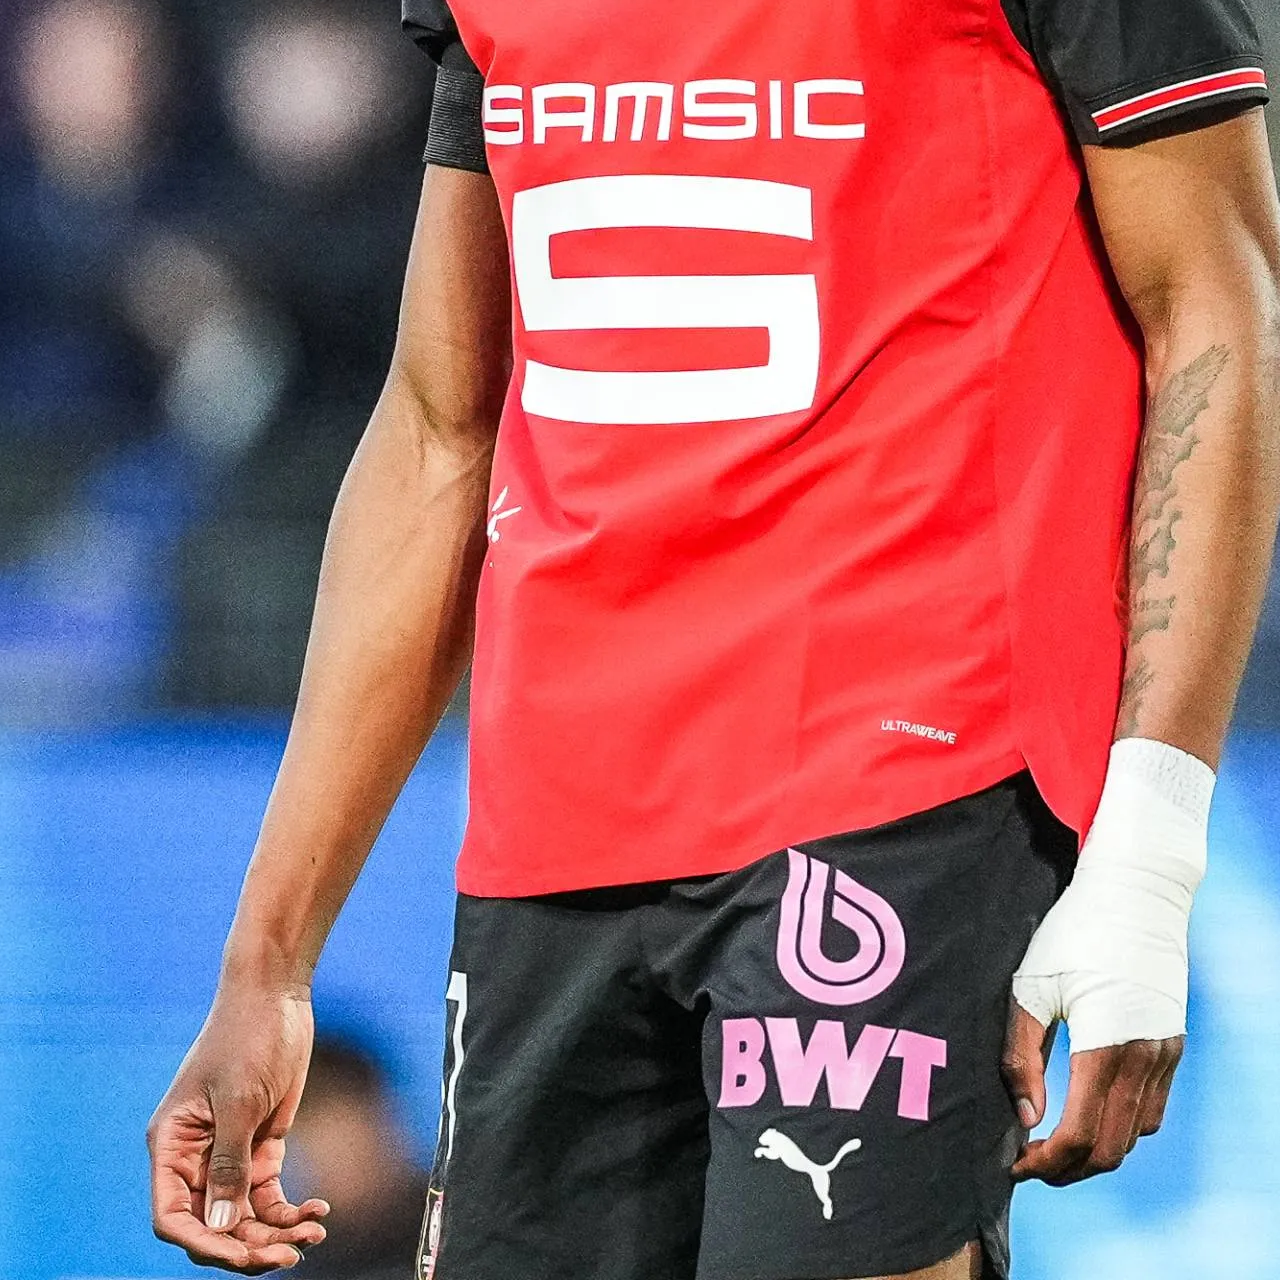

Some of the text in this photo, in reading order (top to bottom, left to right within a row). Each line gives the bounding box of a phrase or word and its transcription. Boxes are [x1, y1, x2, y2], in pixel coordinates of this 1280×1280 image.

[483, 79, 866, 146] SAMSIC
[880, 719, 958, 745] ULTRAWEAVE
[718, 1017, 948, 1122] BWT
